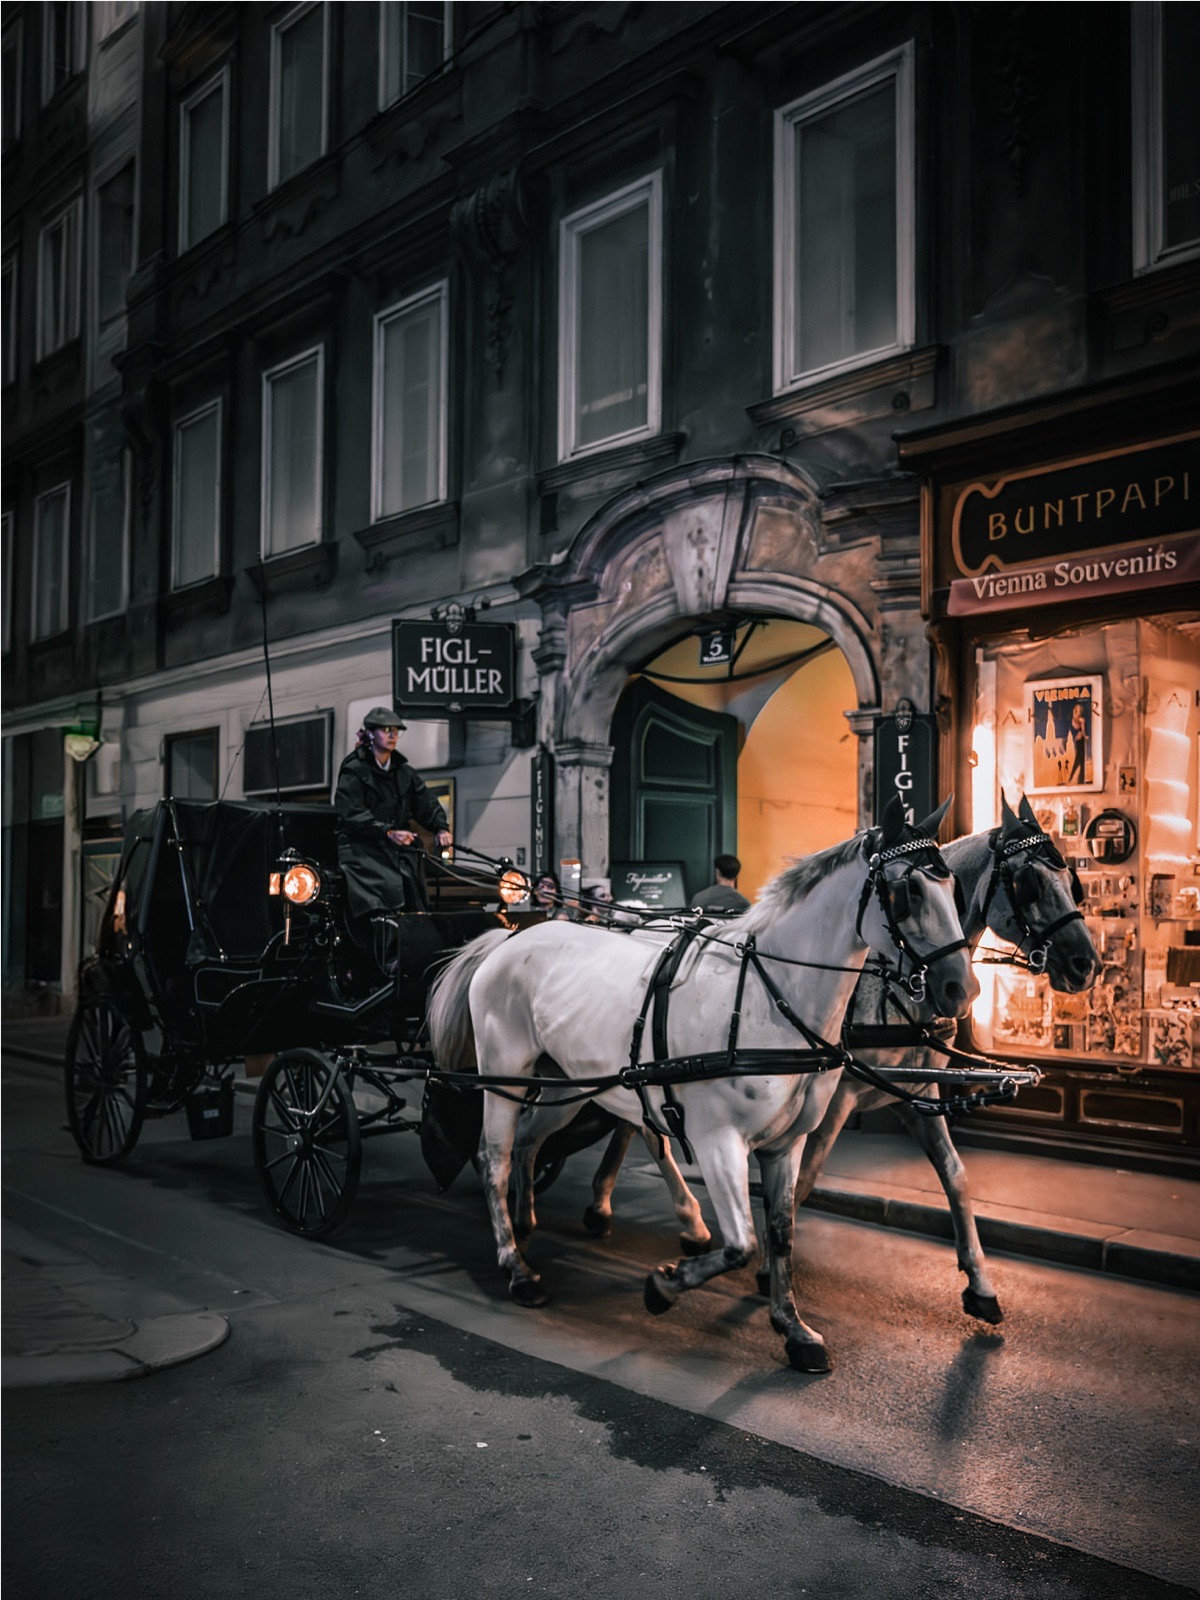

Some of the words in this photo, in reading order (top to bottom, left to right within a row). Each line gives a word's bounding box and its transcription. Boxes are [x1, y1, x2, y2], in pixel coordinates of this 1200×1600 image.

[988, 472, 1190, 541] BUNTPAPI
[971, 574, 1047, 599] Vienna
[709, 636, 723, 657] 5
[407, 665, 504, 694] MÜLLER
[1035, 687, 1091, 702] VIENNA
